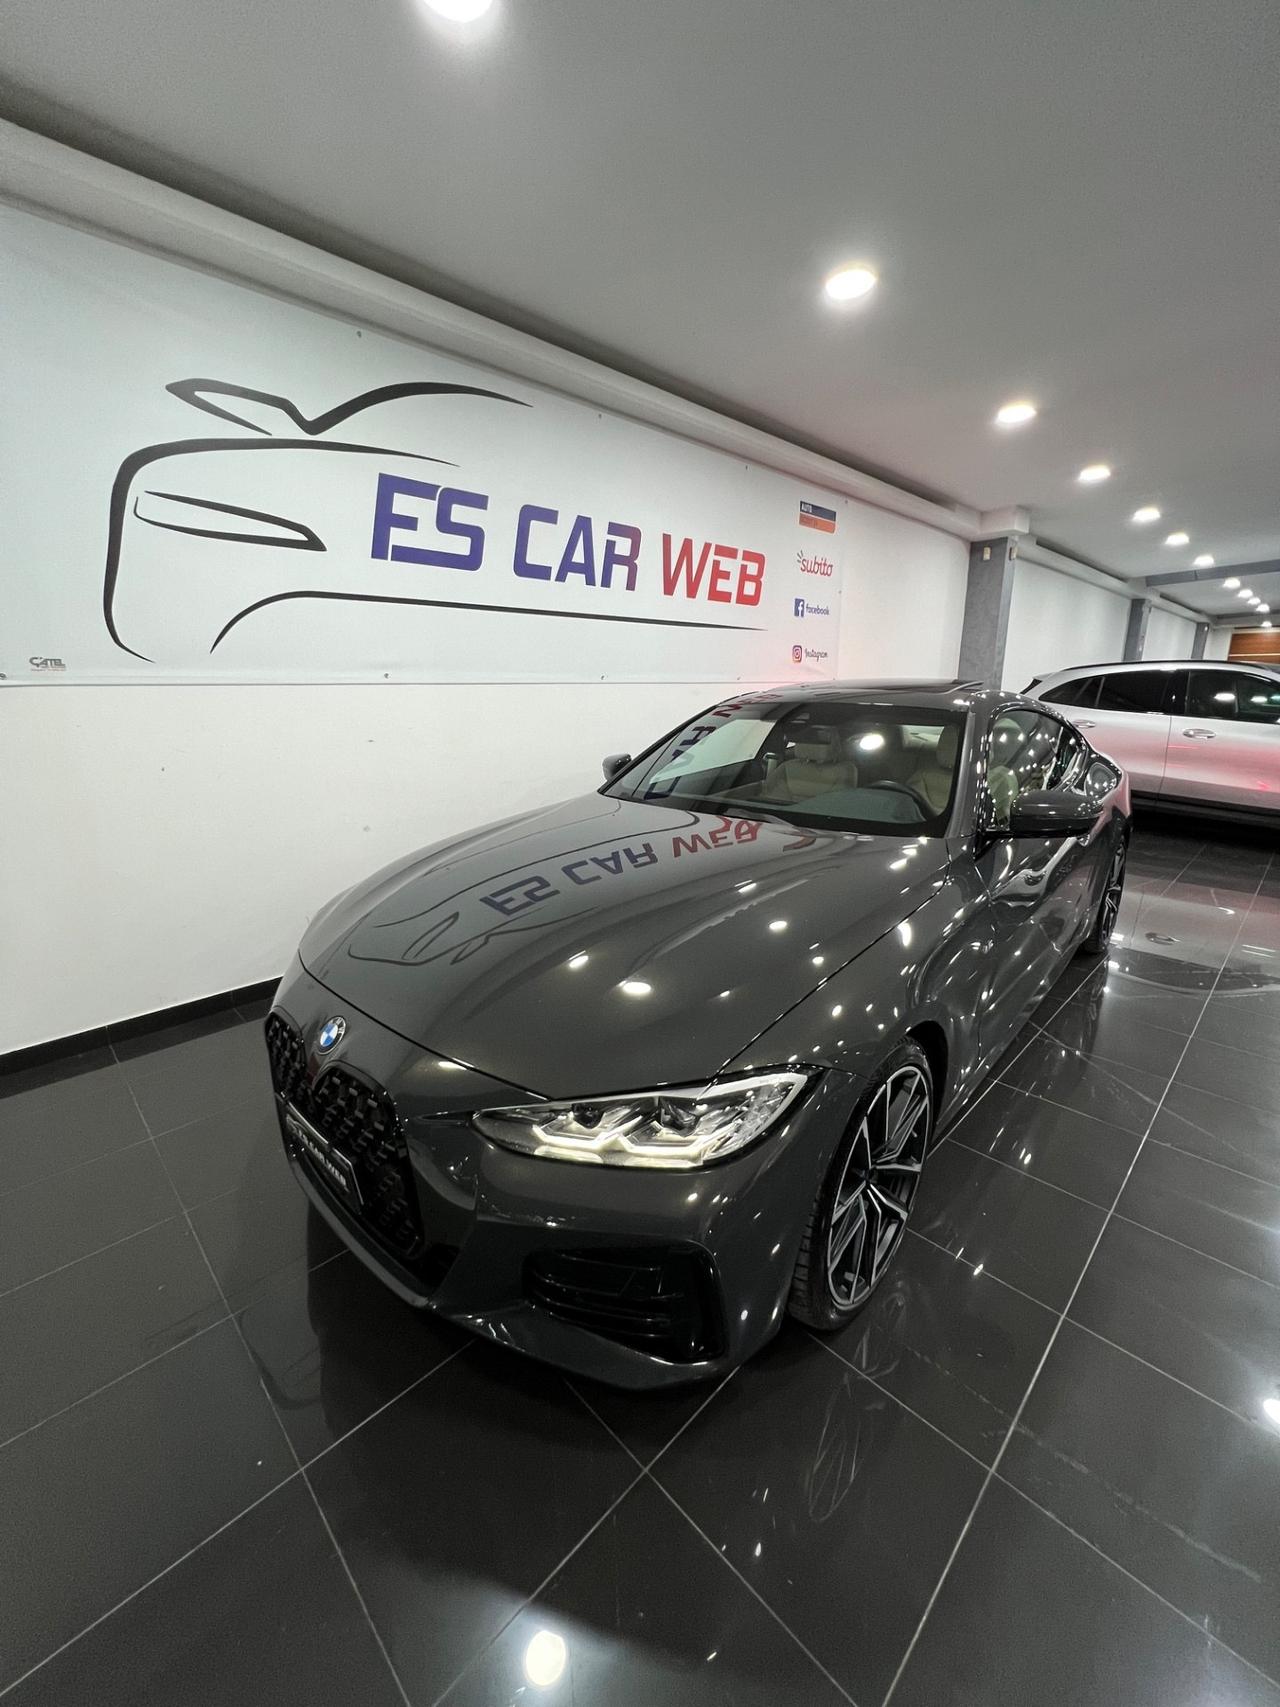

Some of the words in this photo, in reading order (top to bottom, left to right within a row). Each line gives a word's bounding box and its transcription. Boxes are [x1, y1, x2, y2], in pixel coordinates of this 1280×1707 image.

[371, 473, 489, 572] ES
[513, 504, 641, 591] CAR
[662, 532, 766, 607] WEB
[801, 555, 834, 577] subito
[806, 603, 830, 616] facebook
